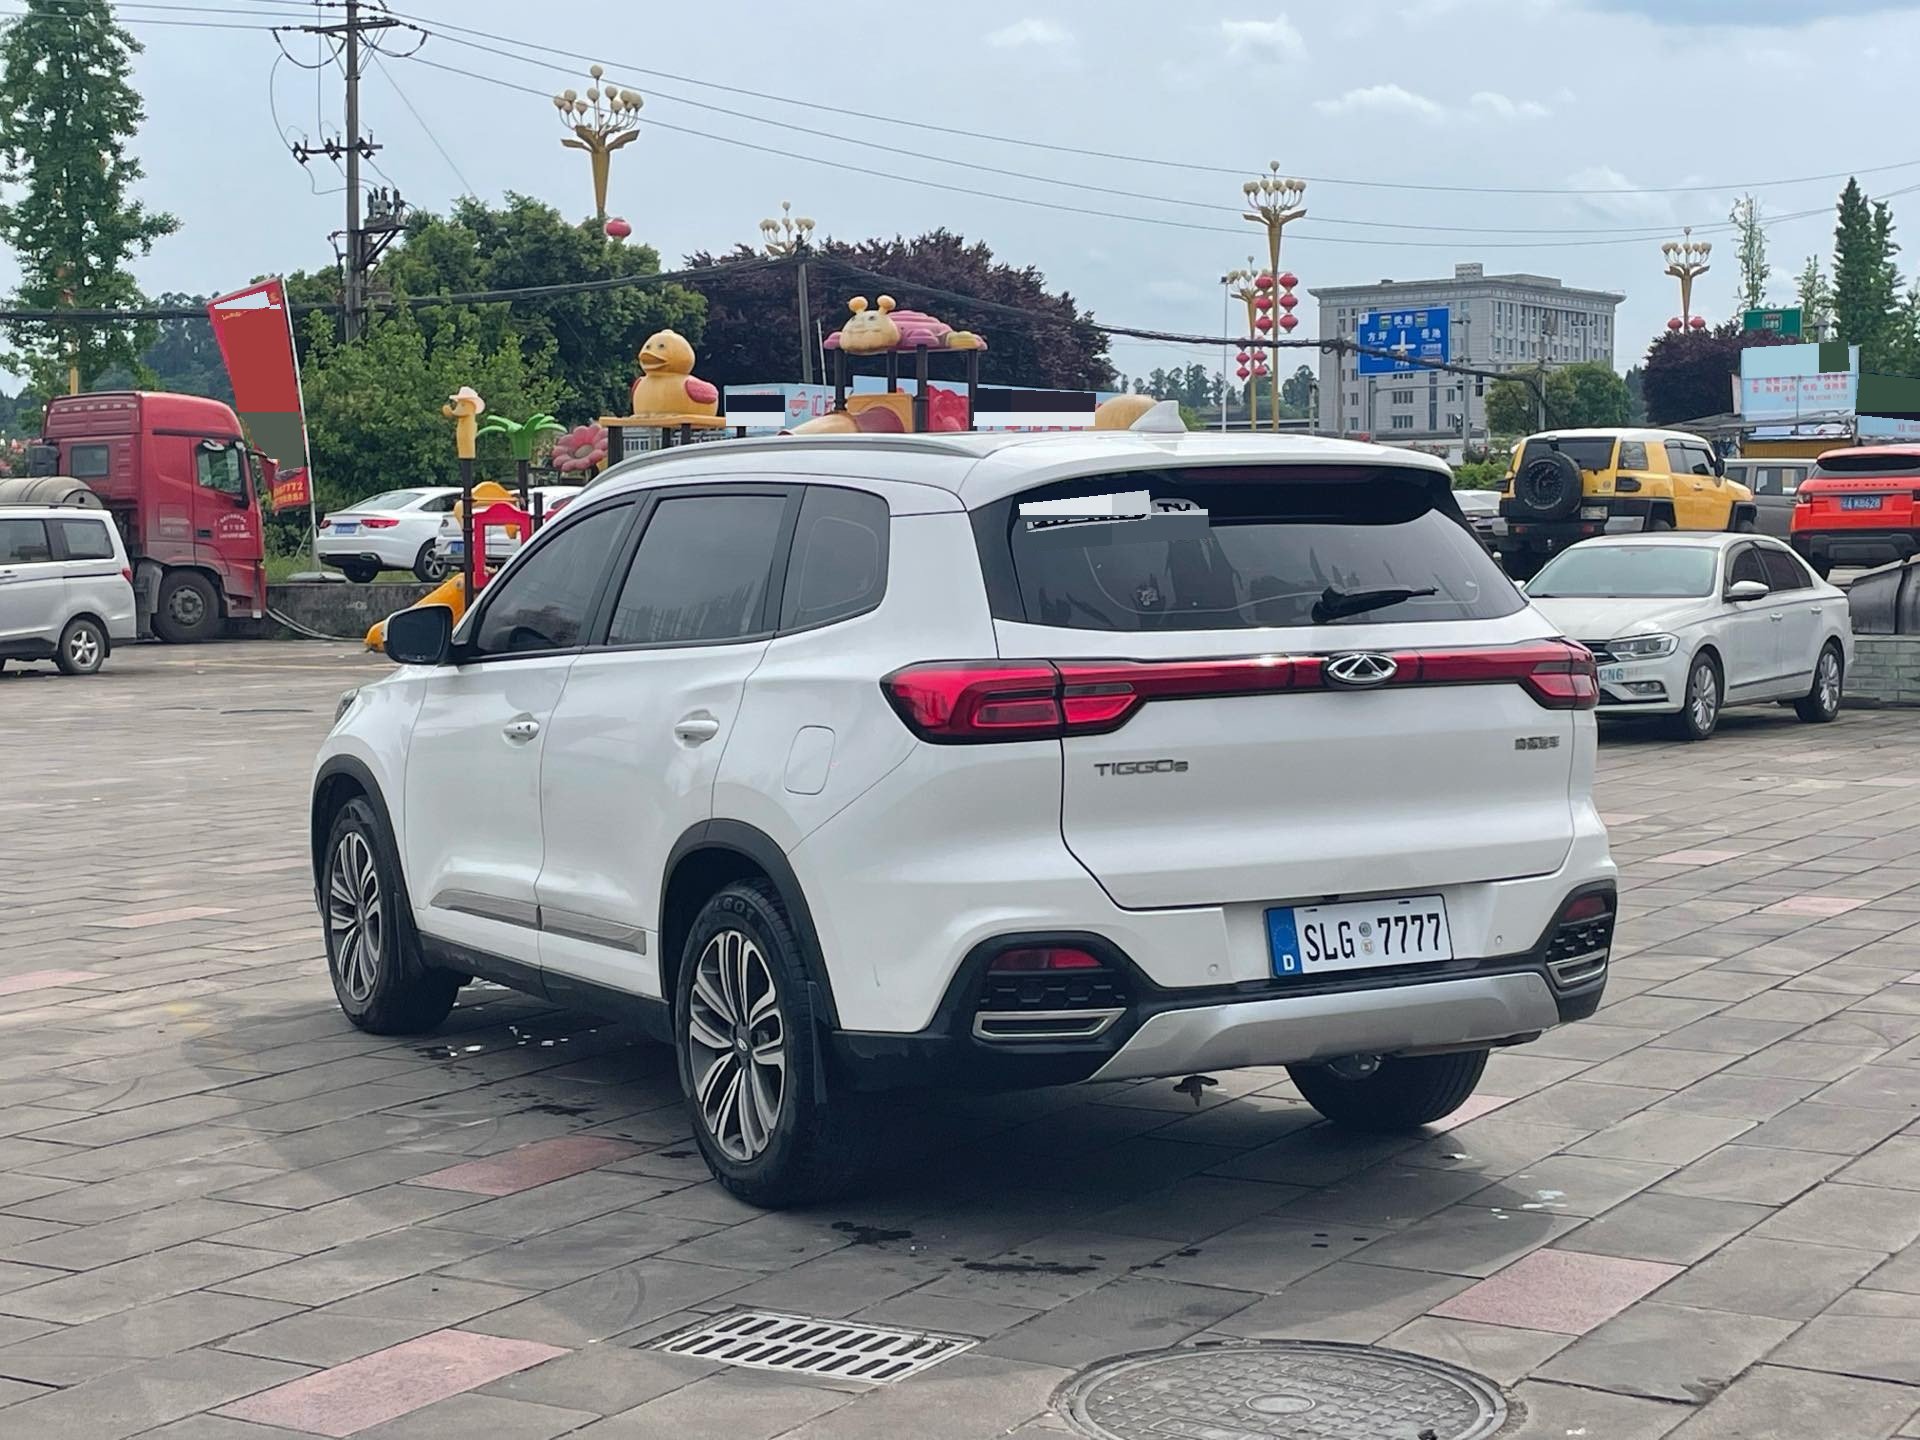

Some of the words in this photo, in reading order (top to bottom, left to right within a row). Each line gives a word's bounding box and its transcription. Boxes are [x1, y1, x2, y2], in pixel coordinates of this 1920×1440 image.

[1282, 954, 1295, 971] D
[1304, 921, 1356, 962] SLG
[1377, 913, 1441, 955] 7777
